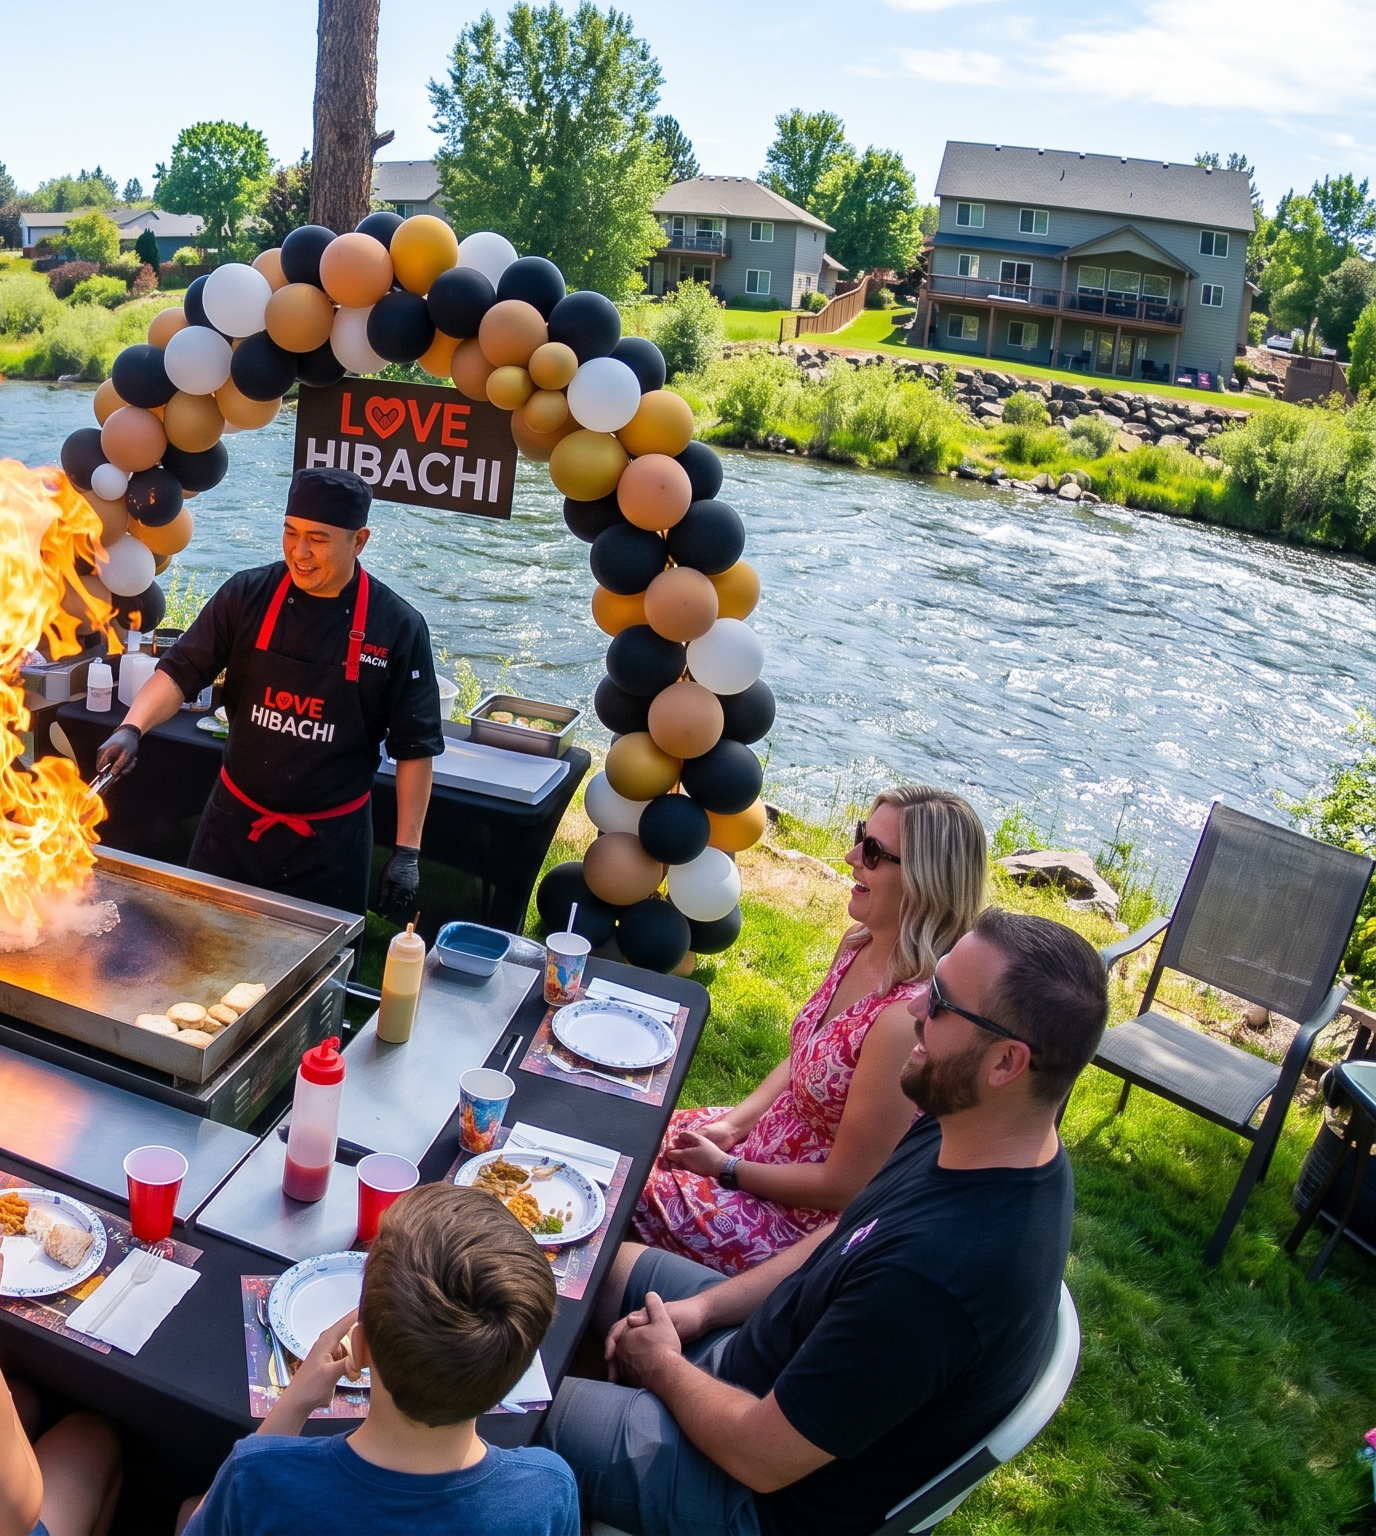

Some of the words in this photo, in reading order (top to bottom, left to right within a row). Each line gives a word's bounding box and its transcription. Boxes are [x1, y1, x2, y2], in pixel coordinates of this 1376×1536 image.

[340, 392, 471, 448] LOVE
[306, 437, 501, 503] HIBACHI
[364, 643, 388, 658] OVE
[264, 686, 325, 719] LOVE
[251, 704, 335, 743] HIBACHI
